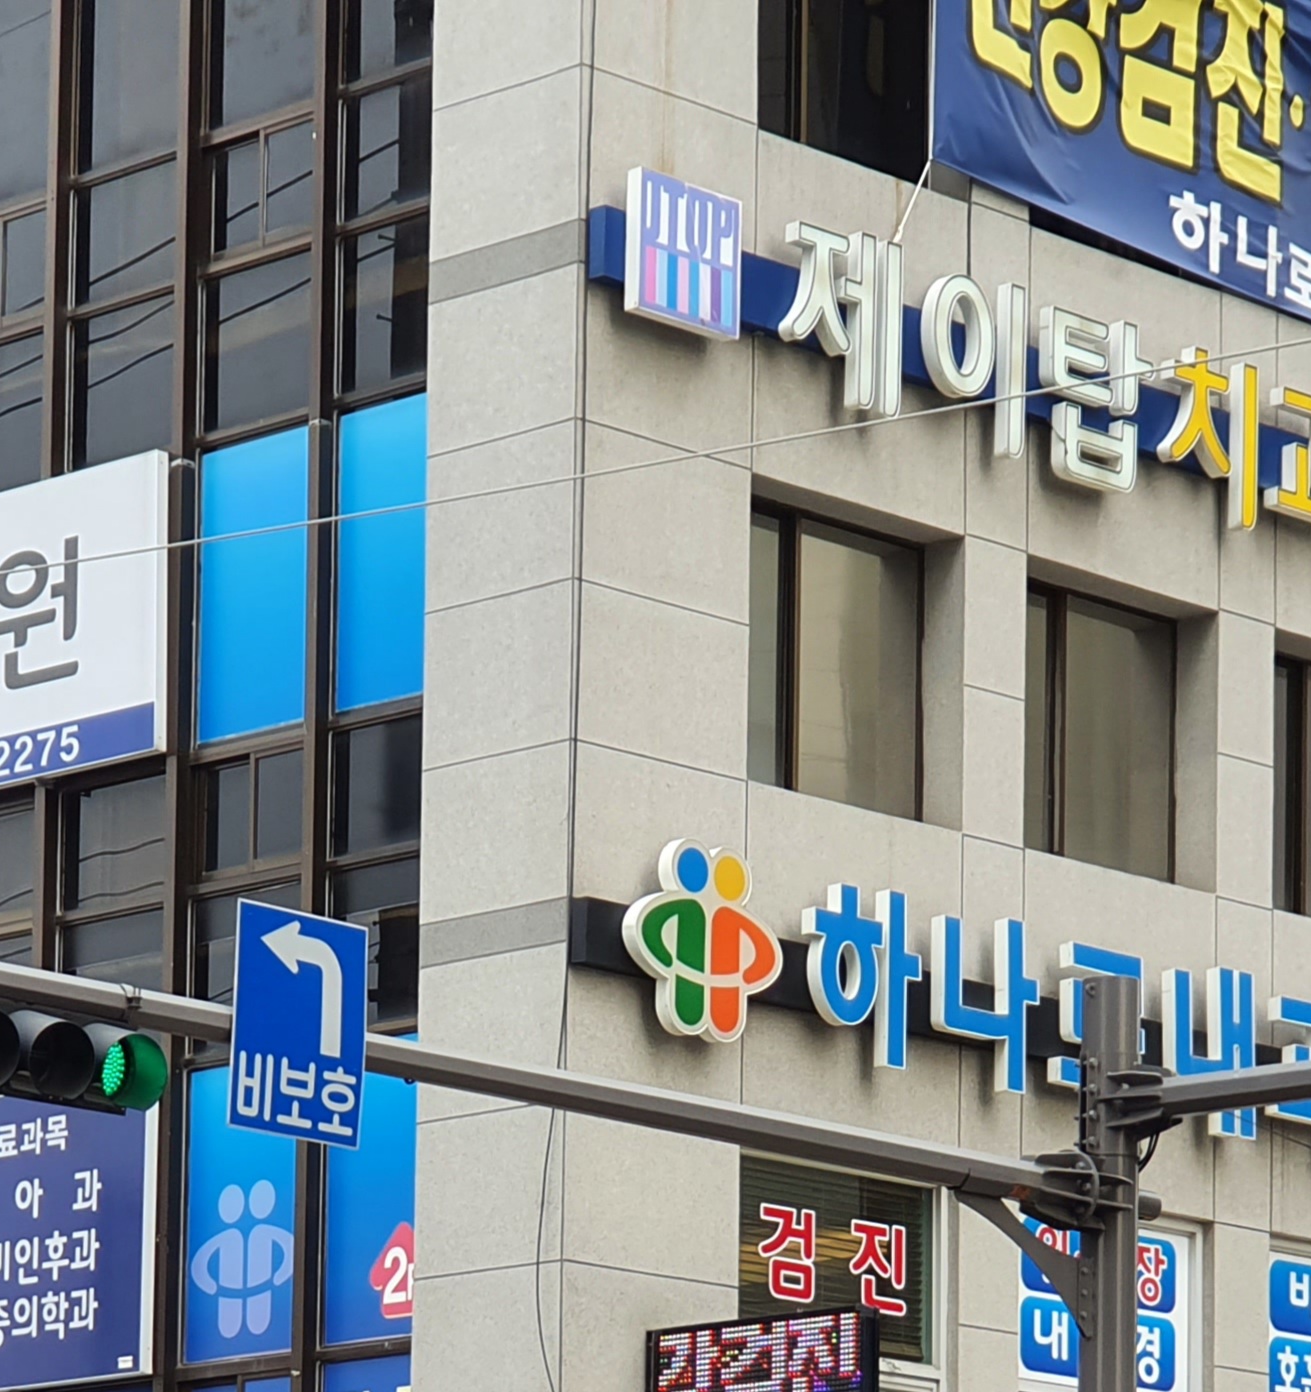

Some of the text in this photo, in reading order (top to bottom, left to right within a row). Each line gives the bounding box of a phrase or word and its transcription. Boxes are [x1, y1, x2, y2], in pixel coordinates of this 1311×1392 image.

[237, 1050, 357, 1137] 비보호
[758, 1201, 907, 1317] 검진
[1033, 1308, 1162, 1385] 내경
